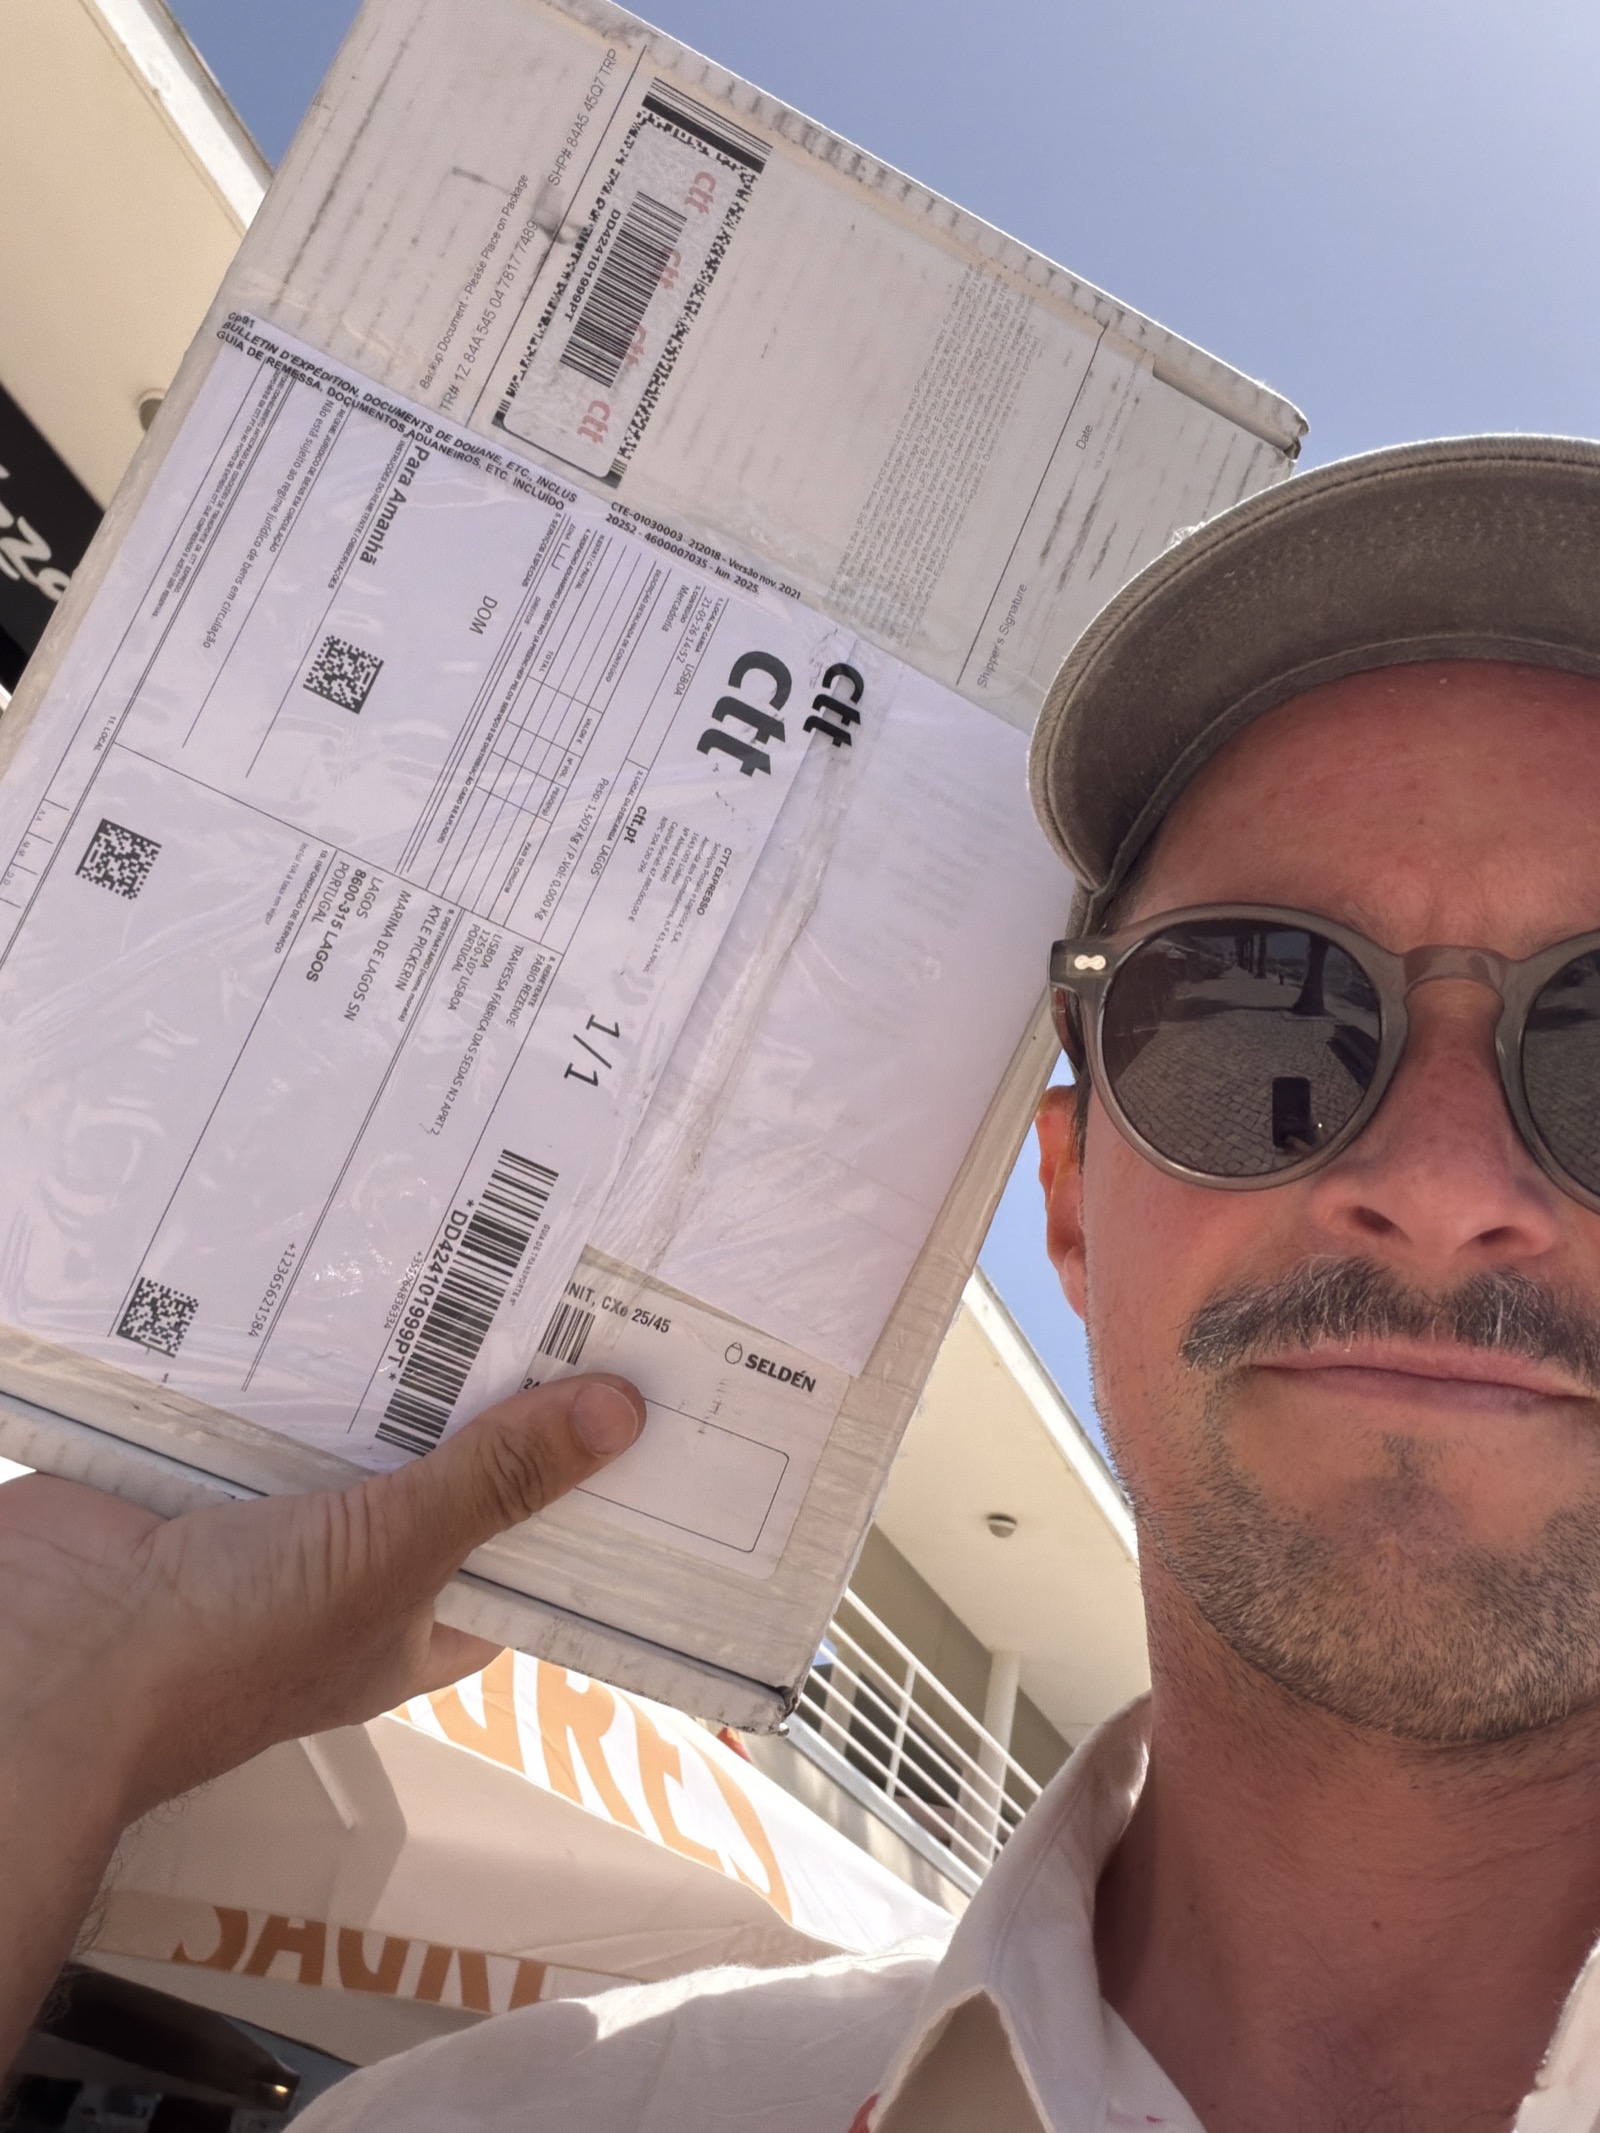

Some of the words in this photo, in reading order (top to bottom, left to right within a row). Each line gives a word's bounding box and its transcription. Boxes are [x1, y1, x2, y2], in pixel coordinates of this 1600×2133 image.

[547, 147, 573, 186] SHP#
[565, 112, 590, 148] 84A5
[582, 75, 606, 112] 45Q7
[598, 47, 618, 76] TRP
[501, 173, 529, 216] Package
[682, 169, 719, 215] ctt
[495, 216, 508, 231] on
[514, 218, 540, 254] 7489
[480, 230, 501, 259] Place
[463, 259, 487, 295] Please
[496, 253, 522, 289] 7817
[563, 208, 621, 322] DD424101999PT
[488, 288, 506, 309] 04
[436, 300, 468, 352] Document
[475, 307, 497, 336] 545
[461, 334, 485, 364] 84A
[418, 351, 444, 390] Backup
[453, 362, 471, 382] 1Z
[221, 320, 279, 354] BULLETIN
[362, 392, 434, 434] DOCUMENTS
[434, 428, 453, 443] DE
[452, 438, 503, 466] DOUANE,
[535, 475, 578, 503] INCLUS
[317, 398, 334, 418] Não
[438, 383, 460, 412] TR#
[215, 329, 245, 352] GUIA
[246, 345, 265, 361] DE
[326, 386, 406, 433] DOCUMENTOS
[405, 428, 482, 469] ADUANEIROS,
[511, 476, 566, 511] INCLUÍDO
[307, 417, 324, 438] está
[576, 398, 614, 445] ctt
[1074, 423, 1094, 450] Date
[292, 437, 314, 469] sujeito
[397, 444, 430, 487] Para
[285, 467, 299, 482] ao
[269, 480, 292, 513] regime
[252, 512, 277, 549] jurídico
[359, 487, 408, 566] Amanhã
[605, 512, 637, 535] 20252
[643, 531, 708, 568] 4600007035
[245, 547, 259, 562] de
[609, 500, 683, 542] CTE-01030003
[687, 538, 722, 561] 212018
[727, 557, 760, 579] Versão
[757, 573, 778, 588] nov.
[777, 582, 802, 600] 2021
[233, 561, 253, 585] bens
[225, 584, 240, 601] em
[660, 584, 690, 633] Mercadoria
[201, 600, 232, 649] circulação
[468, 595, 498, 635] DOM
[687, 596, 713, 637] 21-05-26
[675, 635, 694, 664] 14:52
[975, 636, 1006, 688] Shipper's
[998, 582, 1029, 636] Signature
[673, 662, 695, 697] LISBOA
[696, 646, 804, 780] ctt
[802, 659, 873, 750] ctt
[92, 726, 110, 752] LOCAL
[590, 777, 609, 804] Peso:
[577, 803, 597, 832] 1,502
[622, 804, 648, 844] ctt.pt
[662, 820, 678, 845] Capital
[569, 830, 584, 845] Kg
[692, 835, 710, 863] Avenida
[703, 841, 722, 869] Serviços
[589, 843, 611, 876] LAGOS
[670, 862, 685, 885] Lisboa
[686, 862, 698, 876] dos
[718, 846, 733, 867] CTT
[294, 859, 323, 909] INFORMAÇÃO
[310, 860, 350, 925] PORTUGAL
[355, 876, 383, 919] LAGOS
[541, 878, 562, 908] 0,000
[693, 868, 709, 893] Postais
[695, 865, 724, 916] EXPRESSO
[330, 868, 367, 930] 8600-315
[380, 889, 412, 939] MARINA
[533, 906, 548, 922] Kg
[419, 903, 442, 935] KYLE
[305, 930, 338, 983] LAGOS
[372, 939, 389, 959] DE
[394, 934, 427, 991] PICKERIN
[450, 923, 481, 973] PORTUGAL
[463, 928, 491, 976] 1250-107
[479, 933, 502, 969] LISBOA
[352, 957, 380, 1002] LAGOS
[494, 943, 525, 993] TRAVESSA
[525, 953, 546, 983] FABIO
[527, 963, 552, 1007] REMETENTE
[446, 975, 470, 1011] LISBOA
[505, 982, 532, 1027] REZENDE
[343, 1001, 360, 1022] SN
[476, 991, 503, 1033] FÁBRICA
[466, 1032, 484, 1054] DAS
[559, 1010, 625, 1090] 1/1
[451, 1053, 474, 1087] SEDAS
[444, 1086, 459, 1102] N2
[433, 1101, 452, 1128] APRT
[247, 1242, 297, 1338] +12365621584
[386, 1209, 468, 1368] DD424101999PT
[563, 1279, 598, 1307] NIT,
[630, 1307, 672, 1334] 25/45
[743, 1351, 818, 1393] SELDÉN
